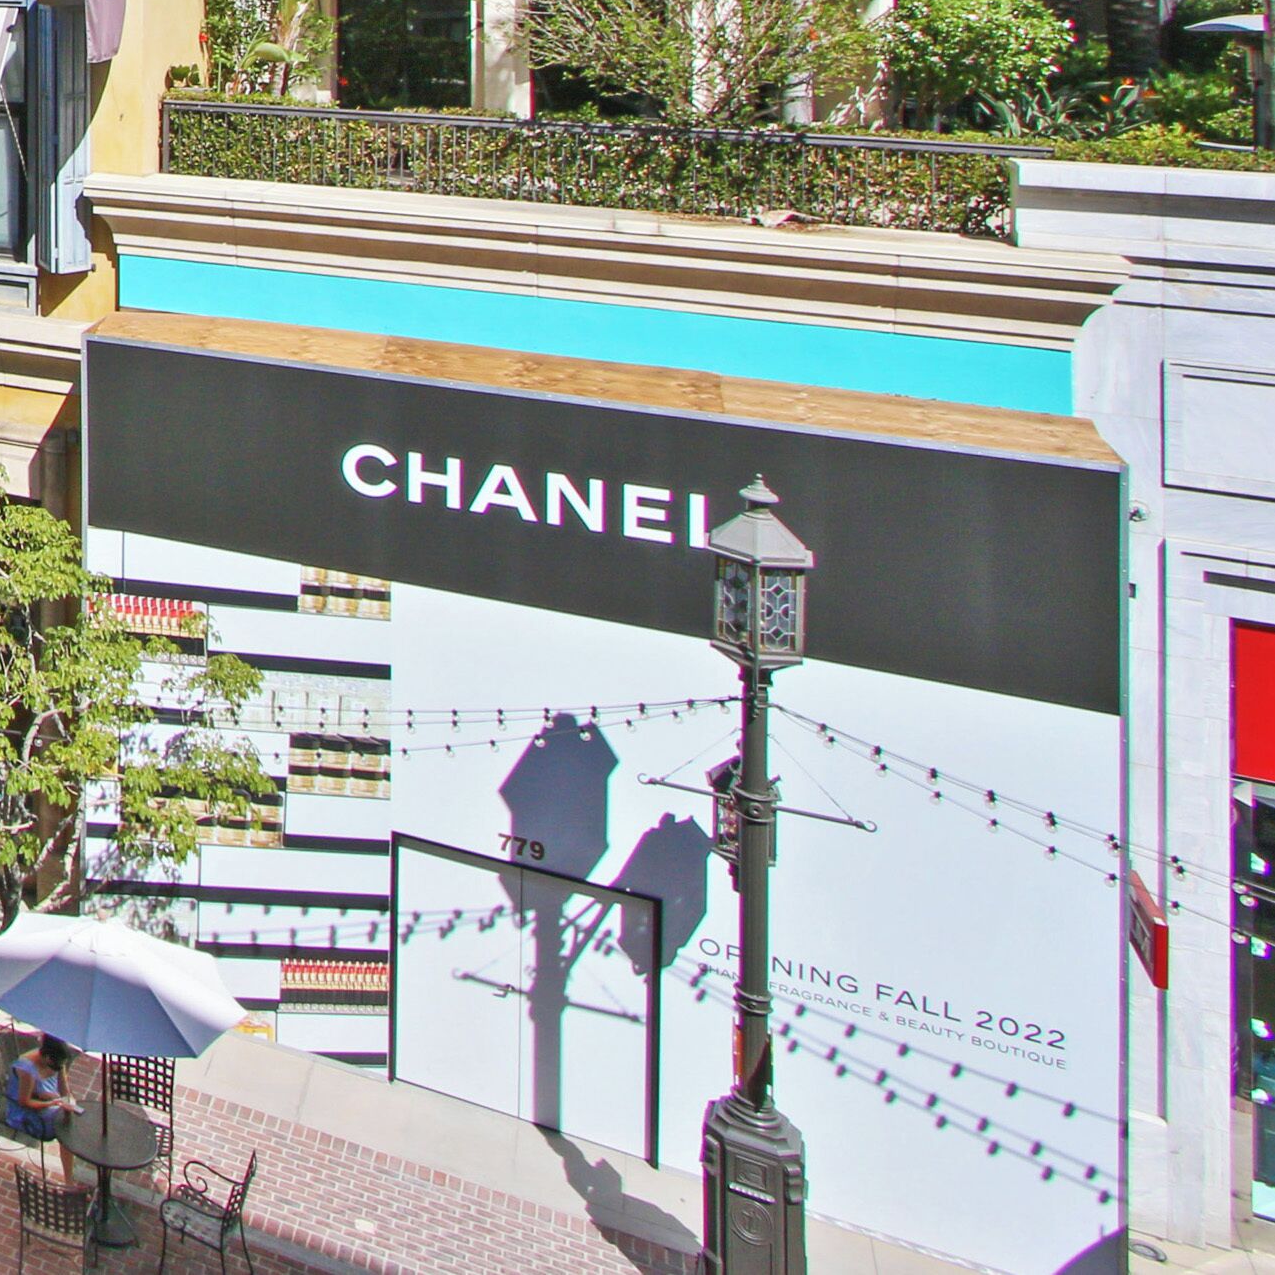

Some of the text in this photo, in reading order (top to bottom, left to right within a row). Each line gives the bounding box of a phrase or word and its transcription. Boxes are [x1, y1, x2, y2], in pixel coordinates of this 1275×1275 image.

[497, 832, 545, 861] 779
[699, 938, 1066, 1050] OPNING FALL 2022
[769, 981, 872, 1017] FRAGRANCE
[878, 1011, 889, 1022] &
[896, 1015, 965, 1041] BEAUTY
[971, 1035, 1067, 1071] BOUTIQUE
